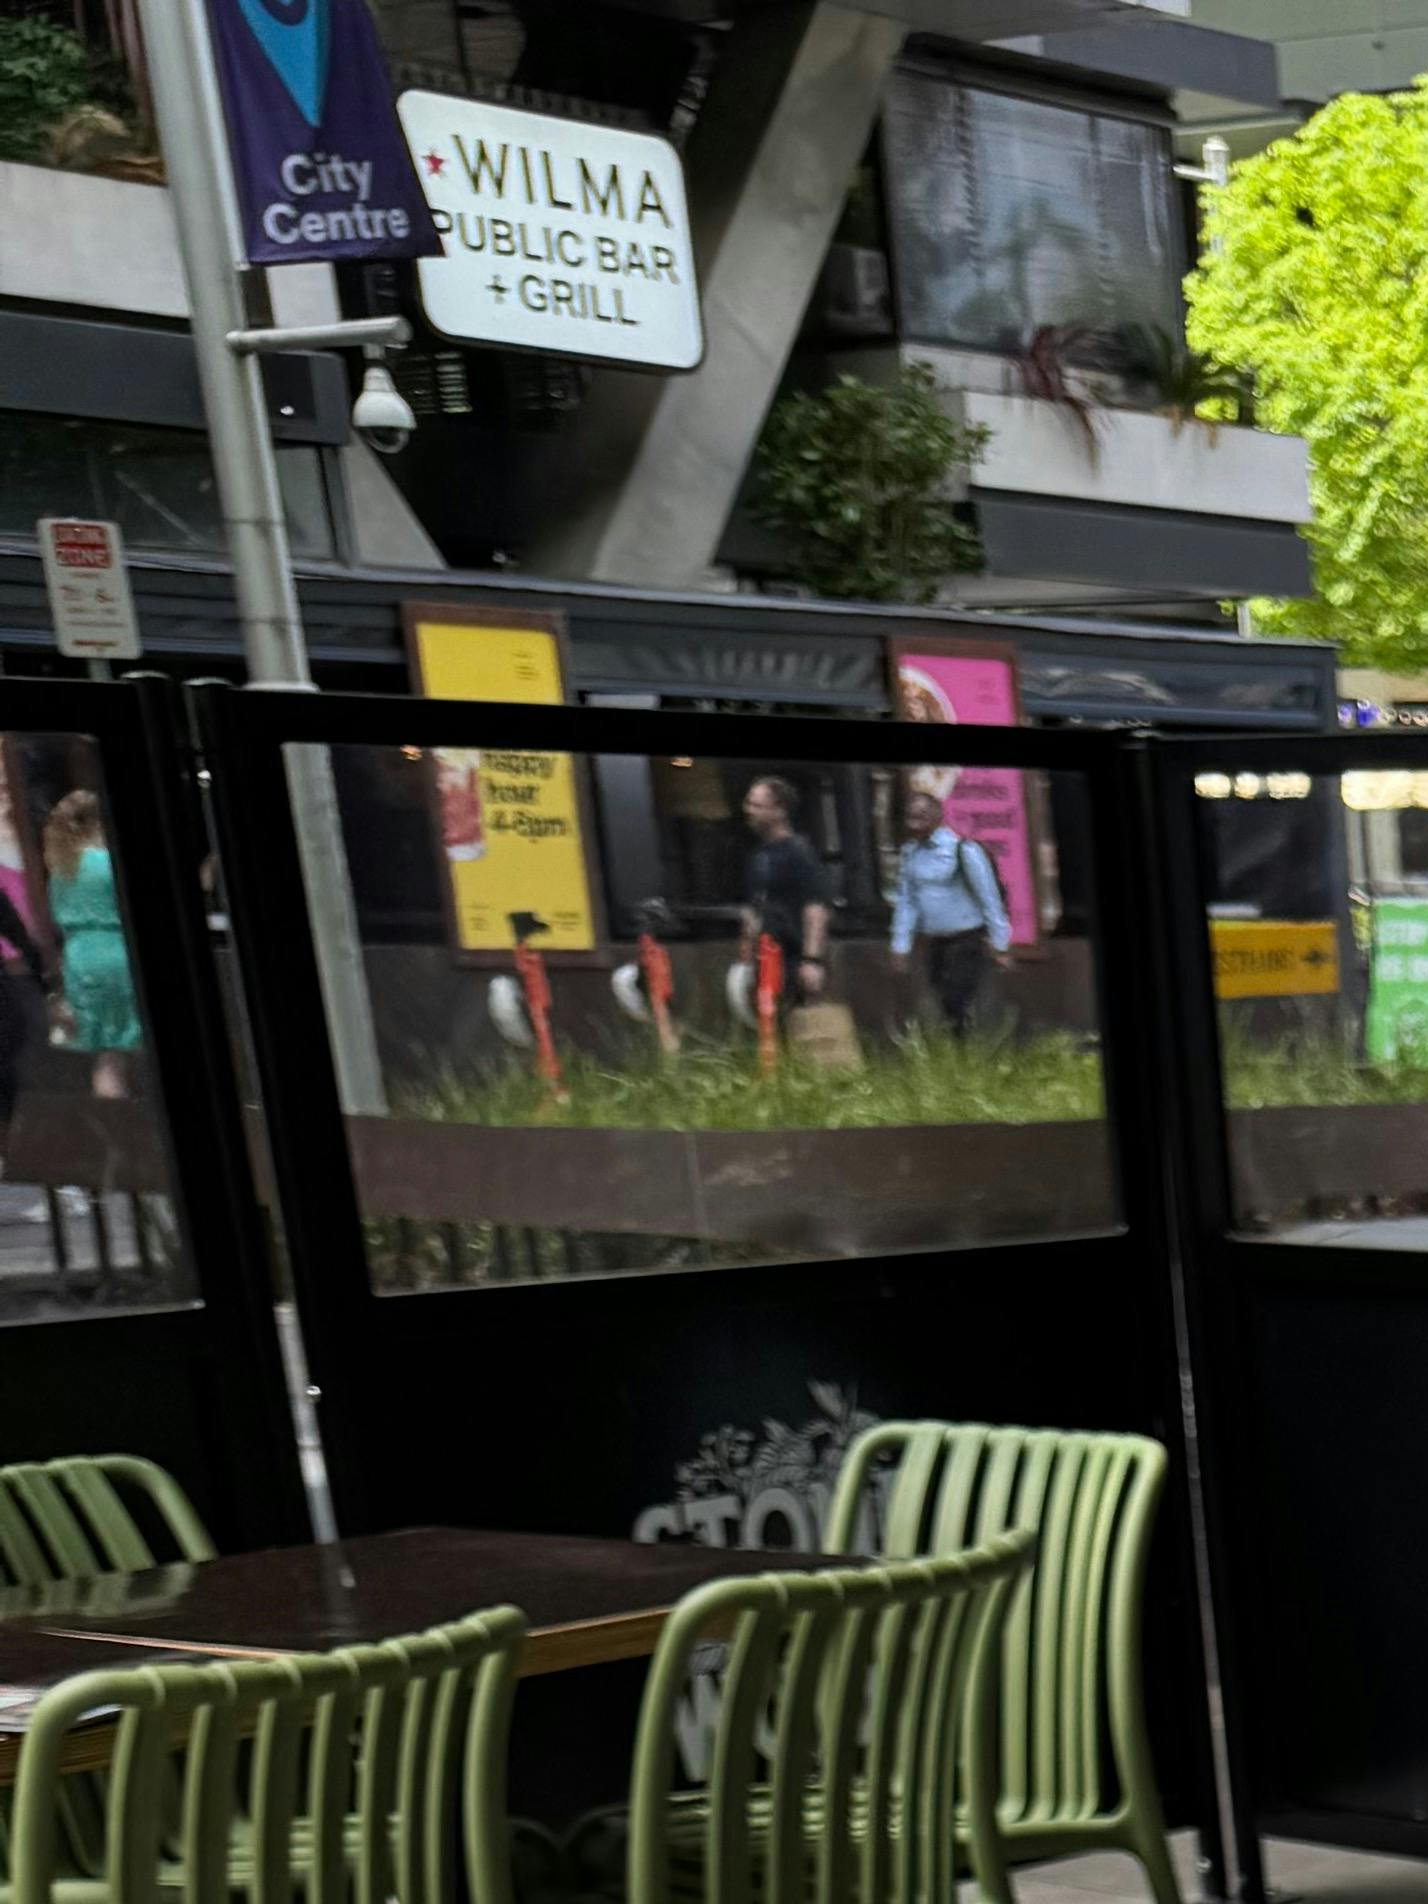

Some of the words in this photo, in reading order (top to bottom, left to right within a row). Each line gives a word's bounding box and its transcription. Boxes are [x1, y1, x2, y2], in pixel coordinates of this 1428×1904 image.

[281, 152, 372, 200] City
[452, 135, 673, 229] WILMA
[263, 204, 411, 245] Centre
[430, 208, 586, 268] PUBLIC
[599, 237, 679, 285] BAR
[517, 274, 640, 327] GRILL
